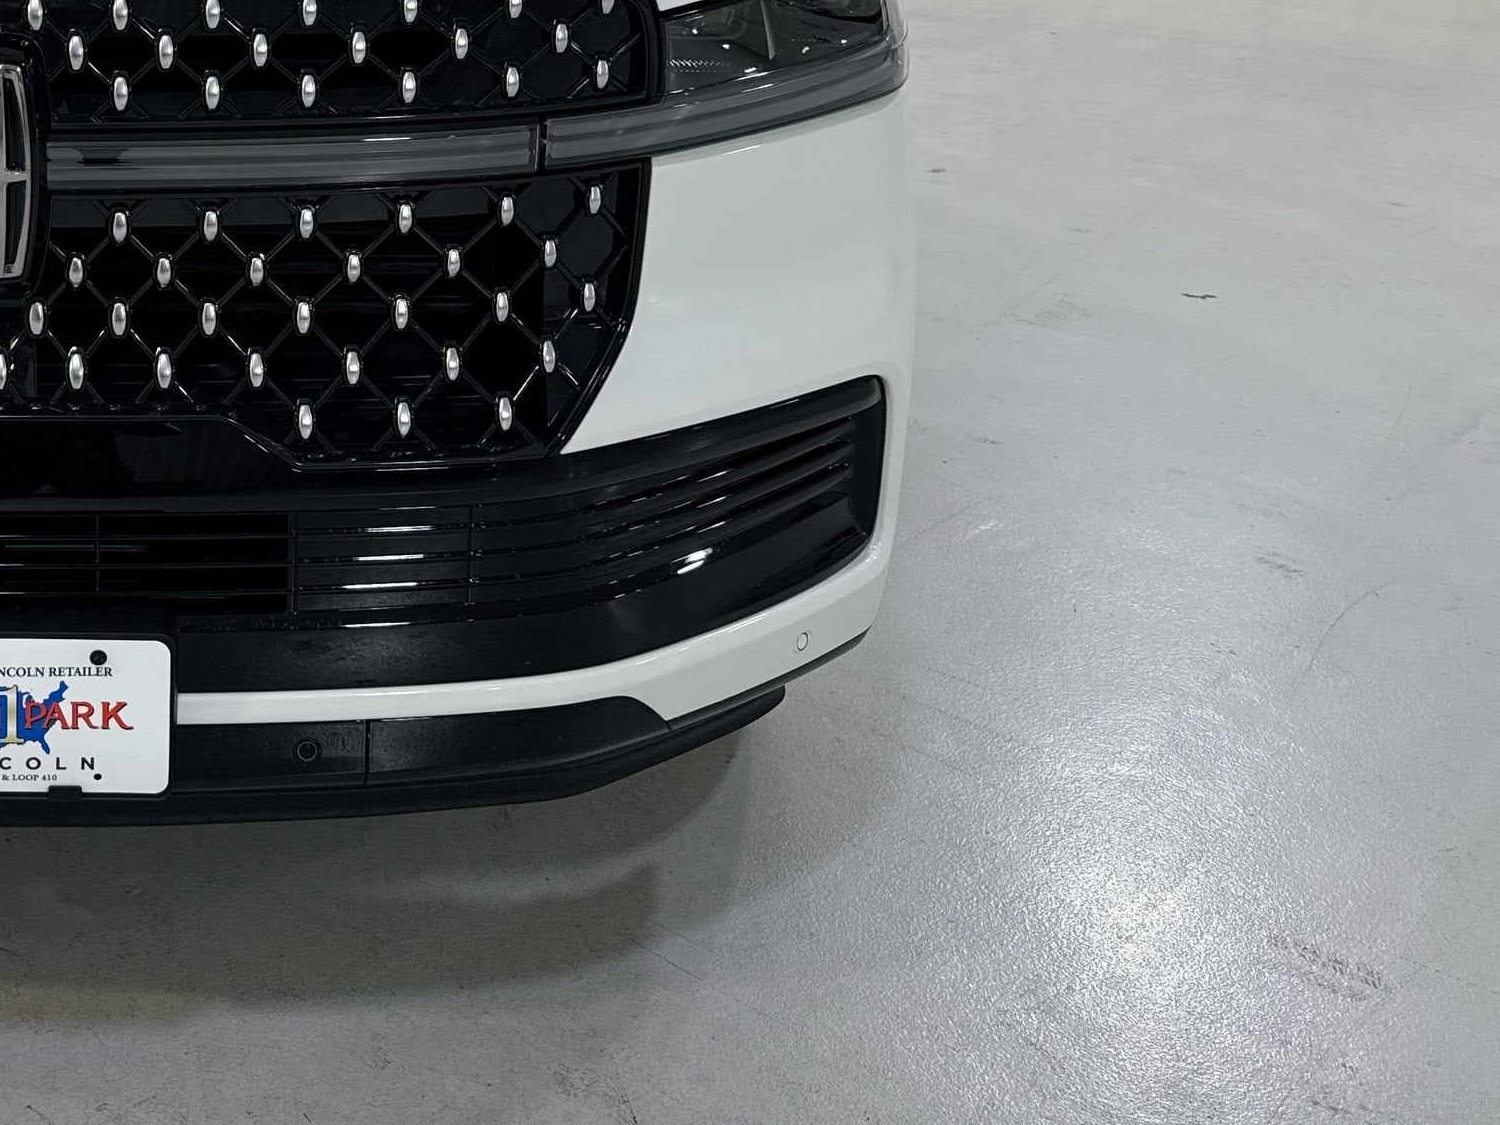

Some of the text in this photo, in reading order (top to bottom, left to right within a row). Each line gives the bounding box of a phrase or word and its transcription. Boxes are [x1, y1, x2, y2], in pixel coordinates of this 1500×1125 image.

[49, 666, 114, 677] RETAILER
[23, 701, 134, 730] PARK
[41, 774, 58, 782] 410
